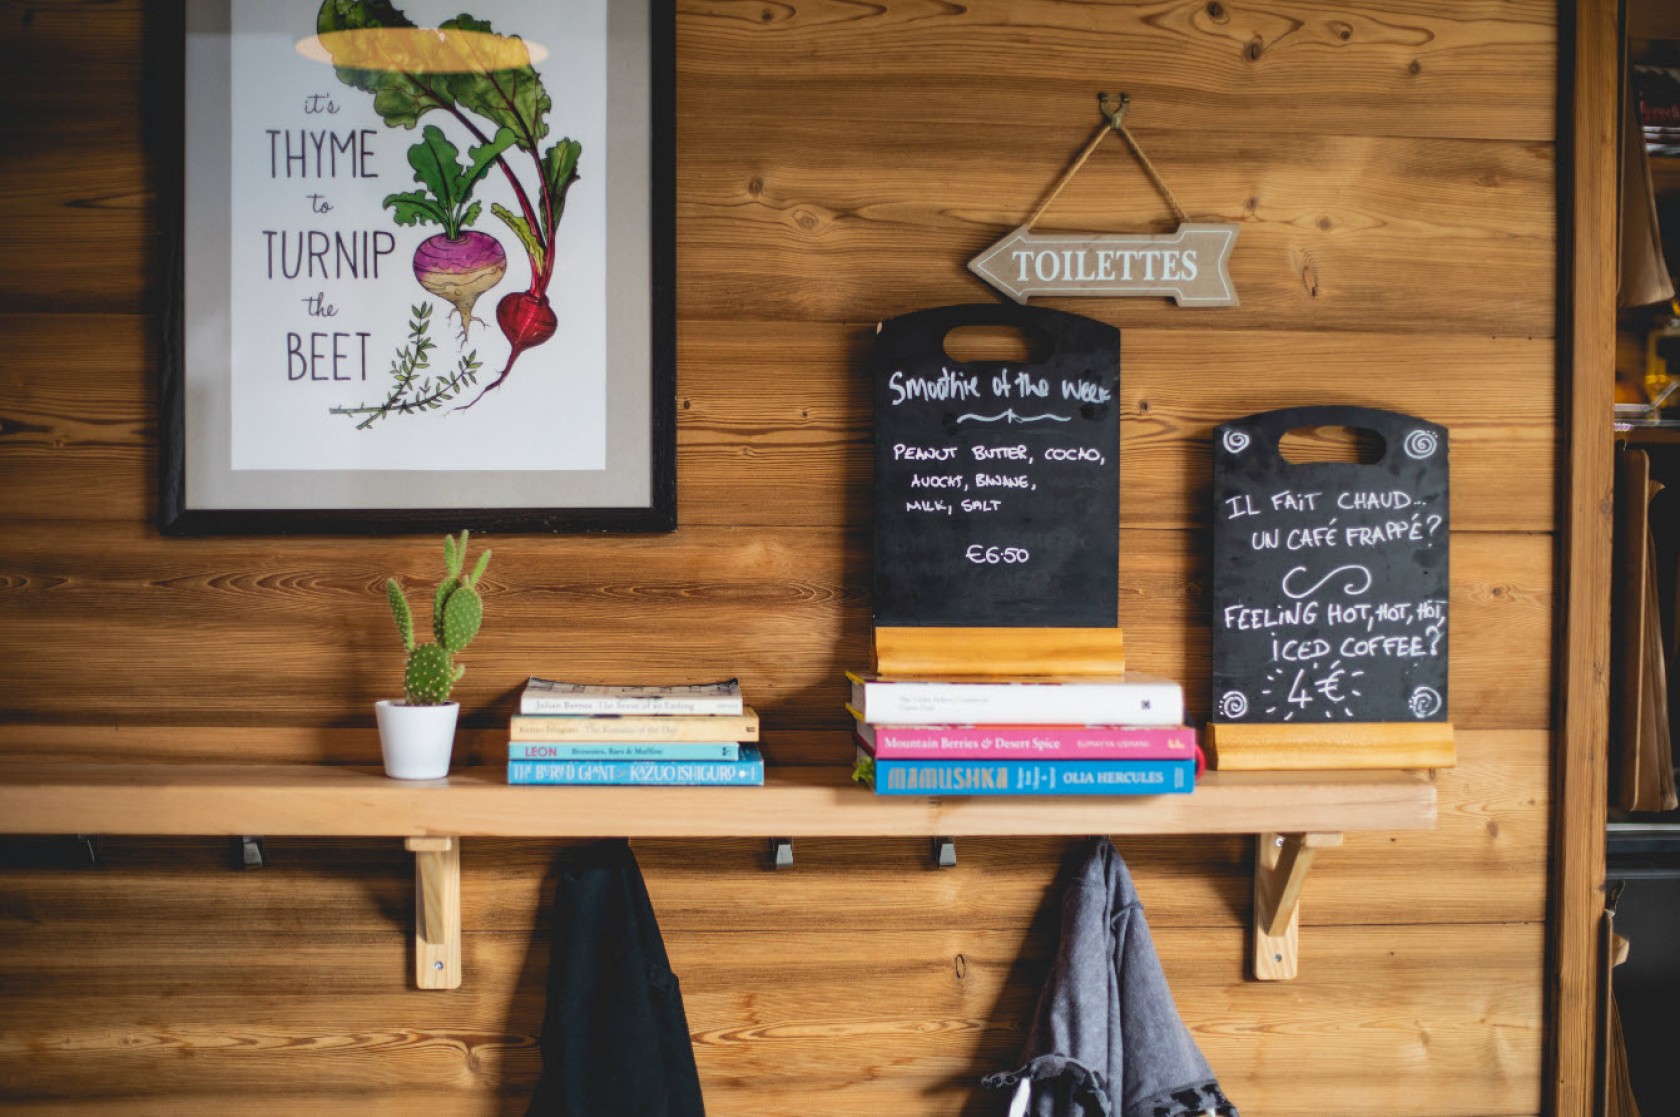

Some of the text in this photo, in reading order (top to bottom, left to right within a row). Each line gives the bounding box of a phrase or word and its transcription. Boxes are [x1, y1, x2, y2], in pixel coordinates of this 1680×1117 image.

[304, 92, 339, 115] it's
[265, 129, 379, 179] THYME
[306, 194, 333, 214] to
[262, 231, 395, 279] TURNIP
[1012, 250, 1198, 281] TOILETTES
[301, 293, 338, 318] the
[287, 332, 370, 381] BEET
[889, 367, 980, 405] Smoothie
[992, 368, 1011, 398] of
[893, 444, 1104, 465] PEANUT BUTTER, COCAO,
[975, 474, 1036, 490] BANANE,
[906, 500, 1001, 515] MILK, SALT
[1225, 495, 1260, 519] IL
[1252, 513, 1442, 550] UN CAFÉ FRAPPÉ?
[1340, 626, 1444, 657] COFFEE?
[525, 747, 557, 757] LEON
[884, 737, 938, 749] Mountain
[941, 737, 978, 749] Berries
[981, 737, 993, 749] &
[995, 737, 1029, 749] Desert
[1031, 737, 1060, 751] Spice
[888, 767, 1009, 789] MAMUSHKA
[1063, 772, 1095, 784] OLIA
[1097, 772, 1163, 784] HERCULES
